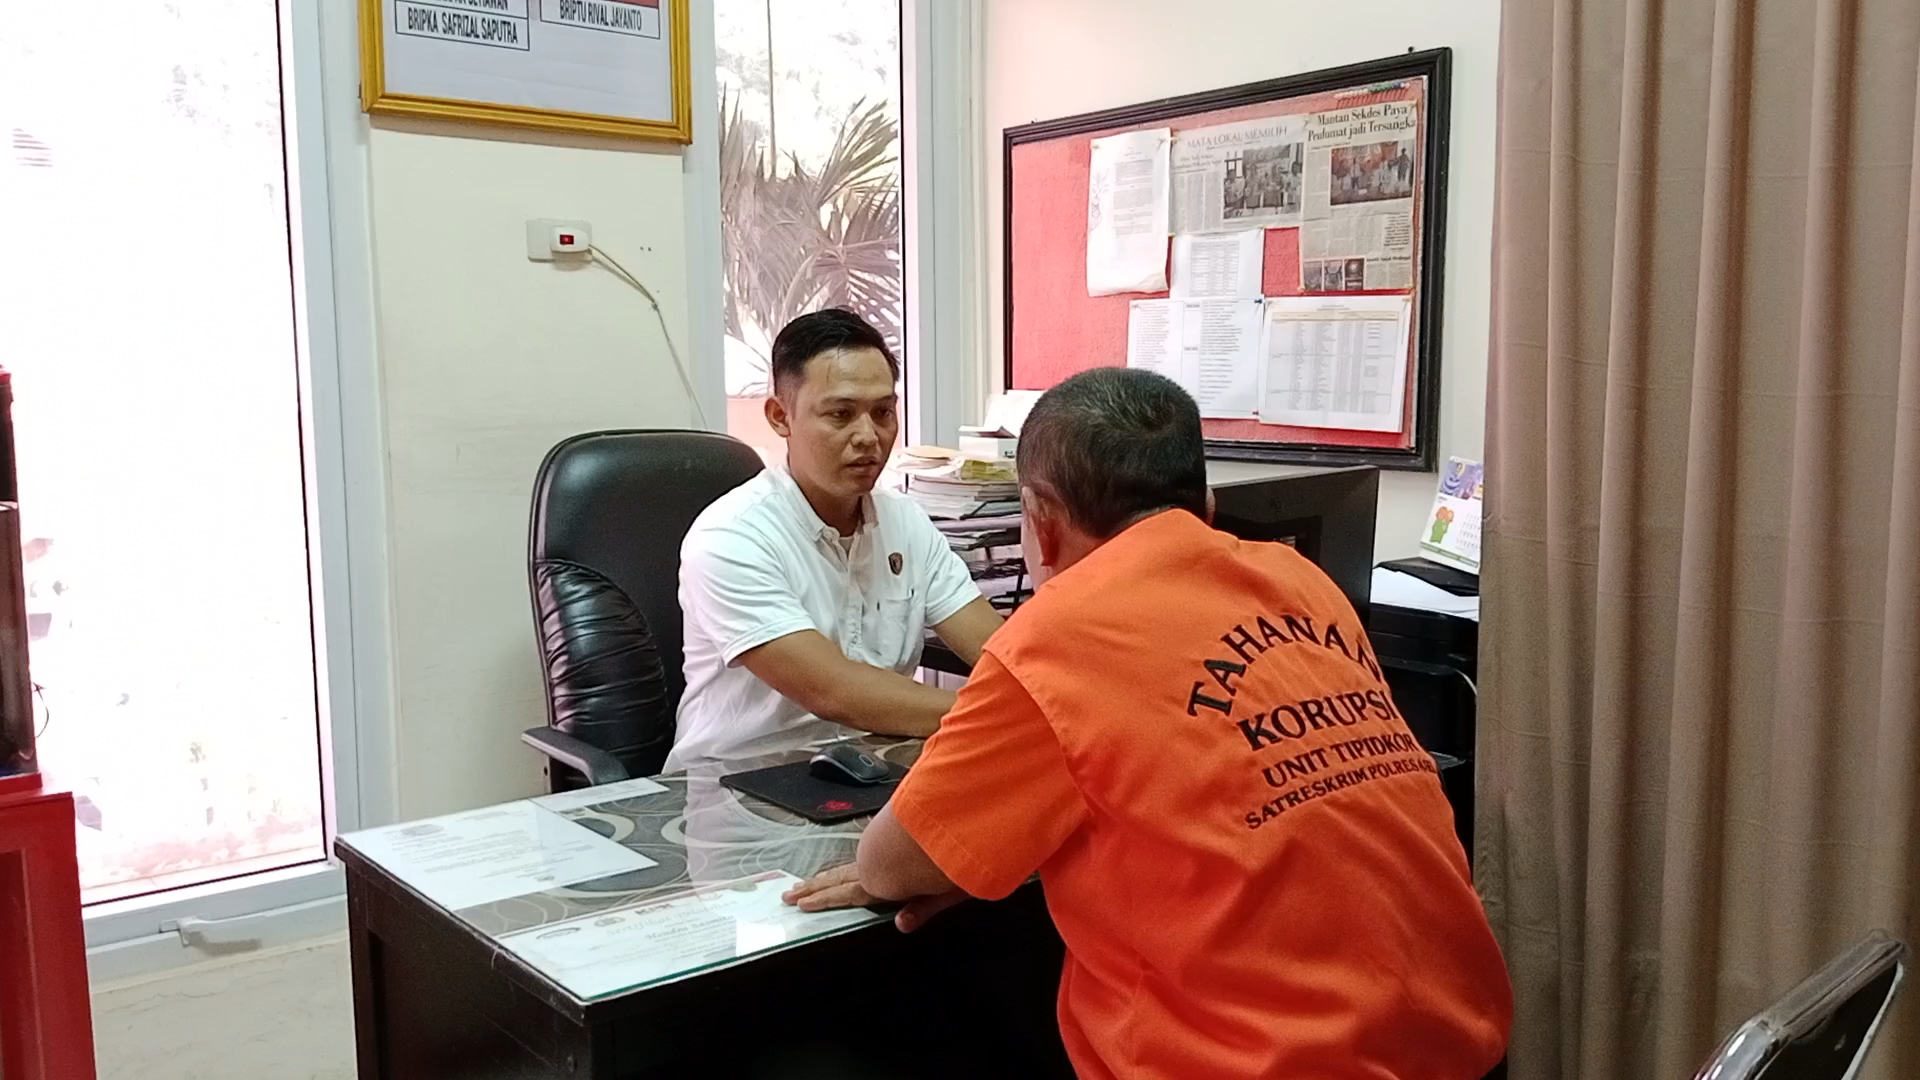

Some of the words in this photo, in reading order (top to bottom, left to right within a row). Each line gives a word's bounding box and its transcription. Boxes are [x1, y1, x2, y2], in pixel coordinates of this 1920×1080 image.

[408, 7, 438, 33] BRIPKA
[441, 12, 479, 39] SAFRIZAL
[481, 18, 518, 43] SAPUTRA
[560, 0, 586, 23] BRIPTU
[588, 2, 609, 26] RIVAL
[611, 6, 642, 30] JAYANTO
[1318, 114, 1349, 126] Mantan
[1352, 106, 1380, 121] Sekdes
[1384, 104, 1407, 120] Paya
[1347, 120, 1367, 139] jadi
[1368, 116, 1416, 133] Tersangka
[1187, 615, 1382, 716] TAHANAN
[1237, 689, 1398, 751] KORUPSI
[1262, 748, 1329, 788] UNIT
[1329, 733, 1420, 763] TIPIDKOR
[1245, 766, 1368, 830] SATRESKRIM
[1368, 758, 1419, 779] POLRES
